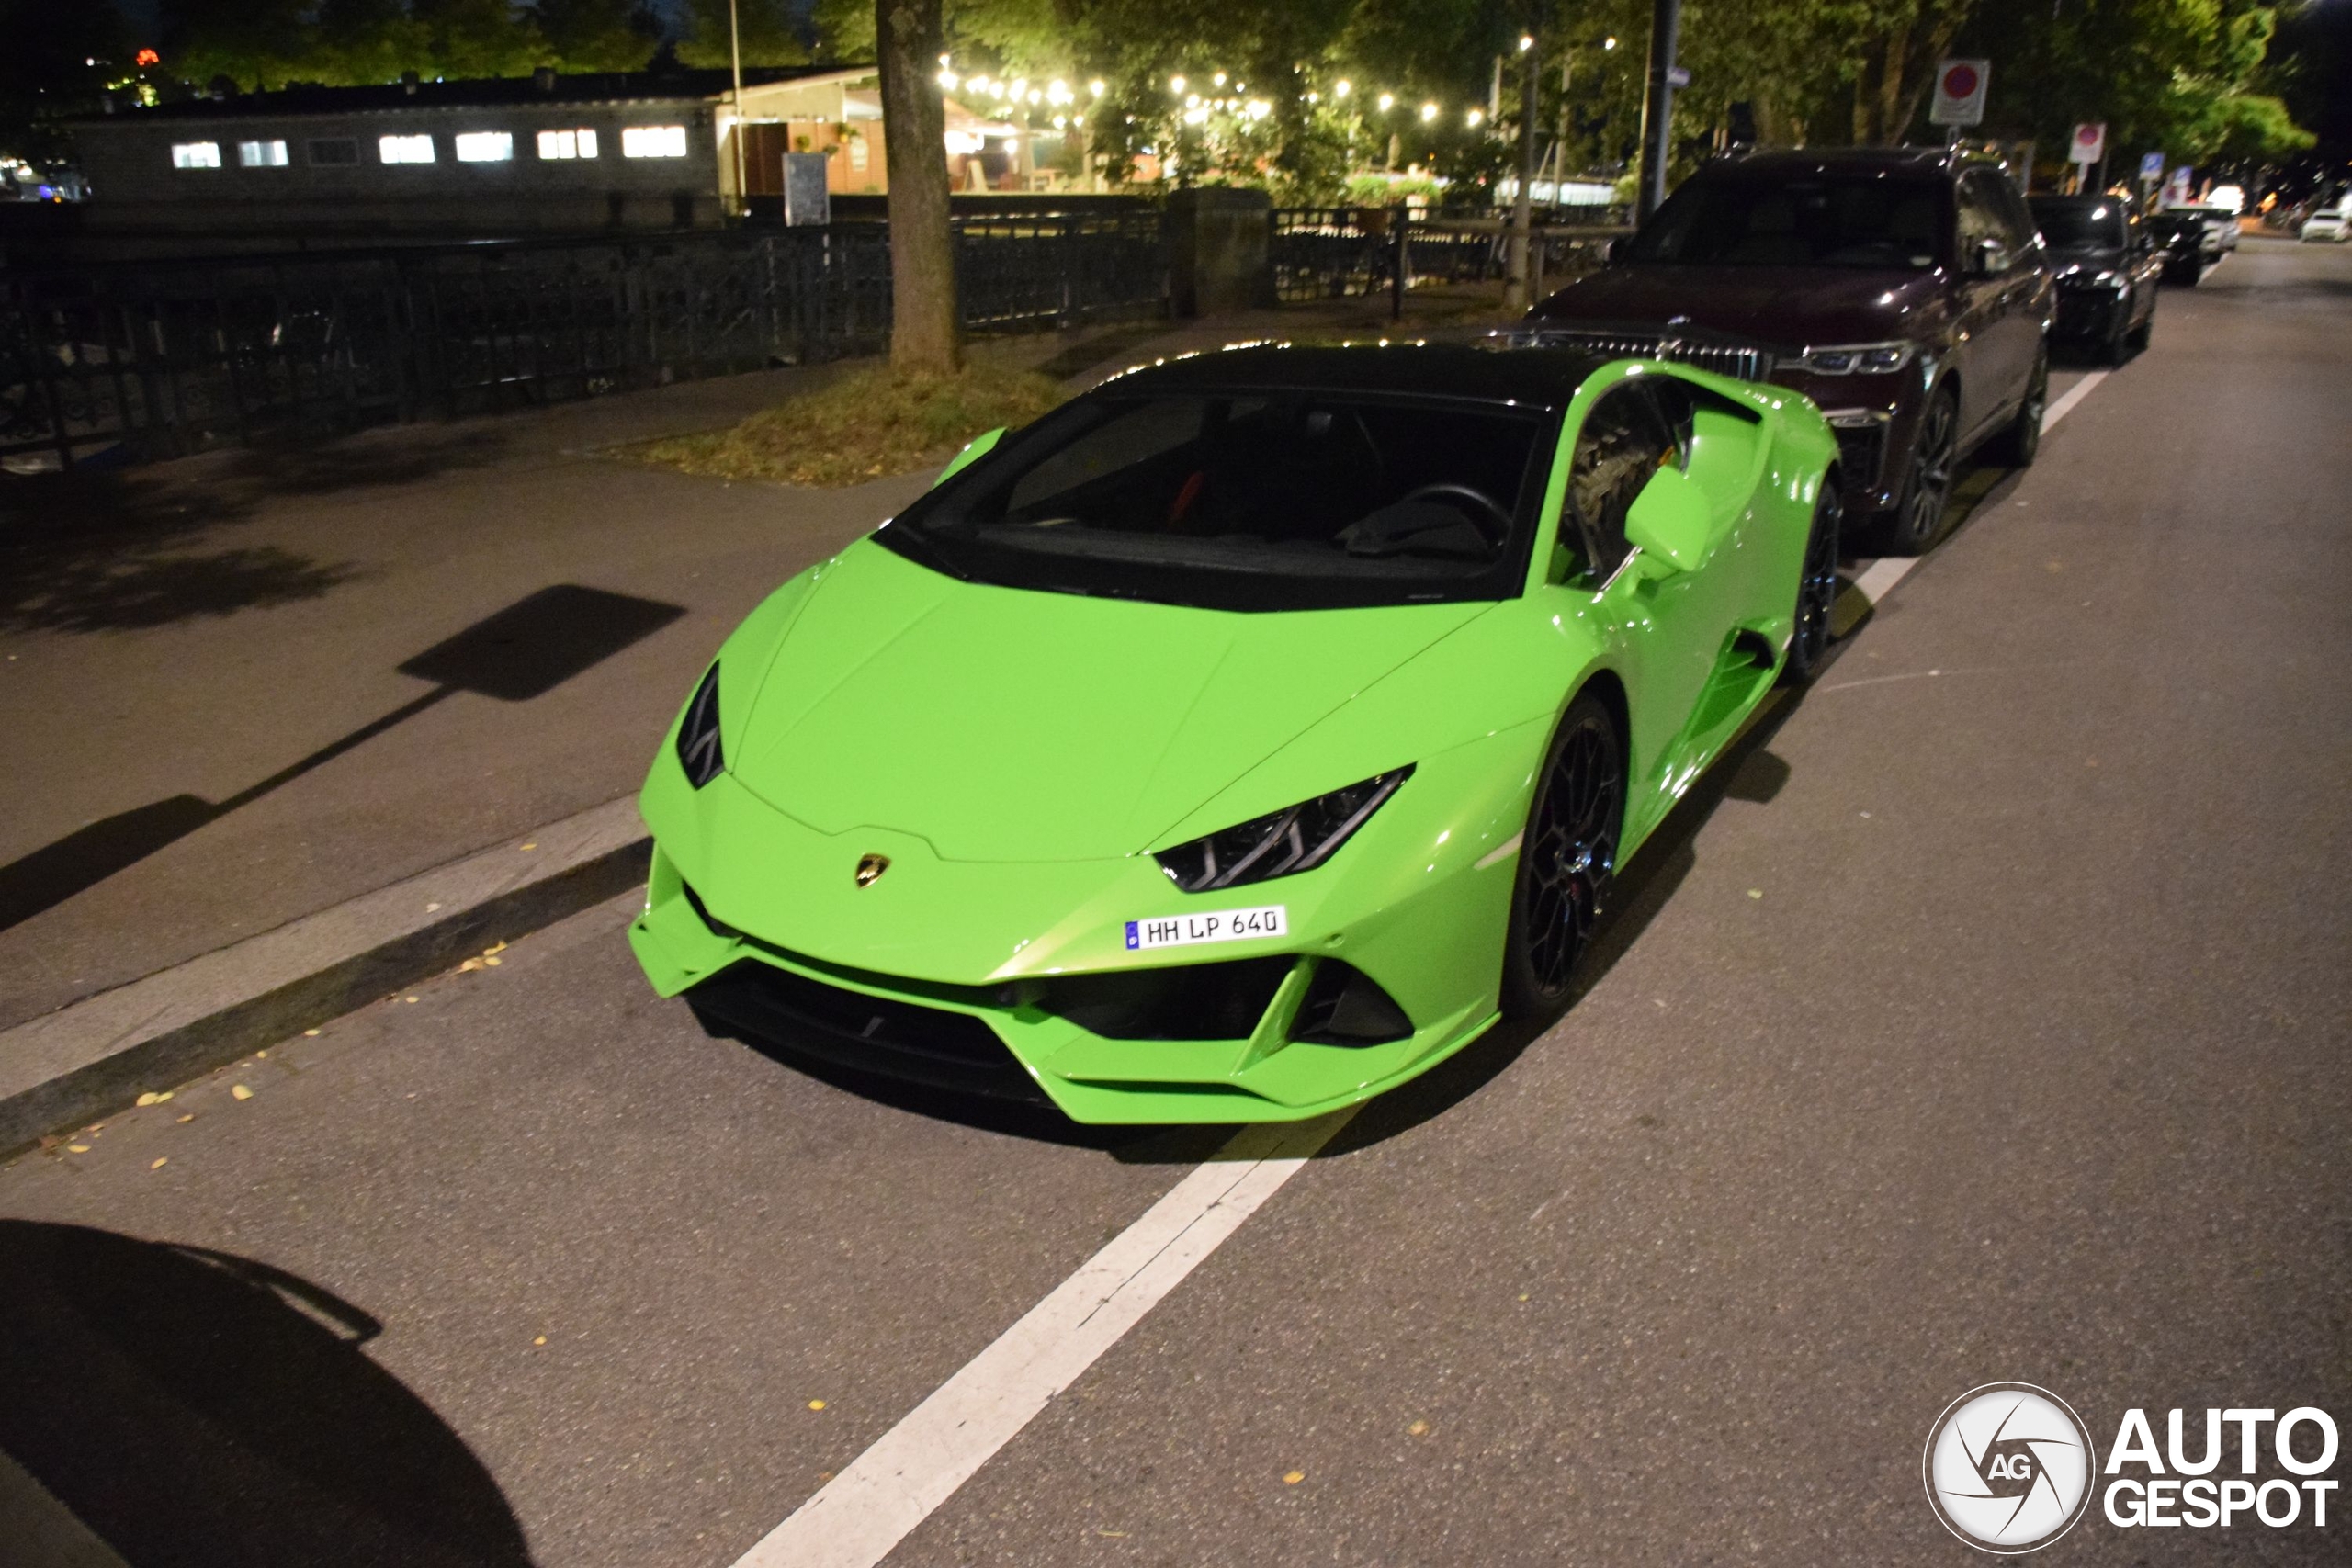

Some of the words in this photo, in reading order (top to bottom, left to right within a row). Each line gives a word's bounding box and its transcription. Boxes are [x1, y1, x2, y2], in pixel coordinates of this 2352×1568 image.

[1148, 920, 1180, 943] HH
[1189, 917, 1220, 939] LP
[1232, 911, 1278, 934] 640
